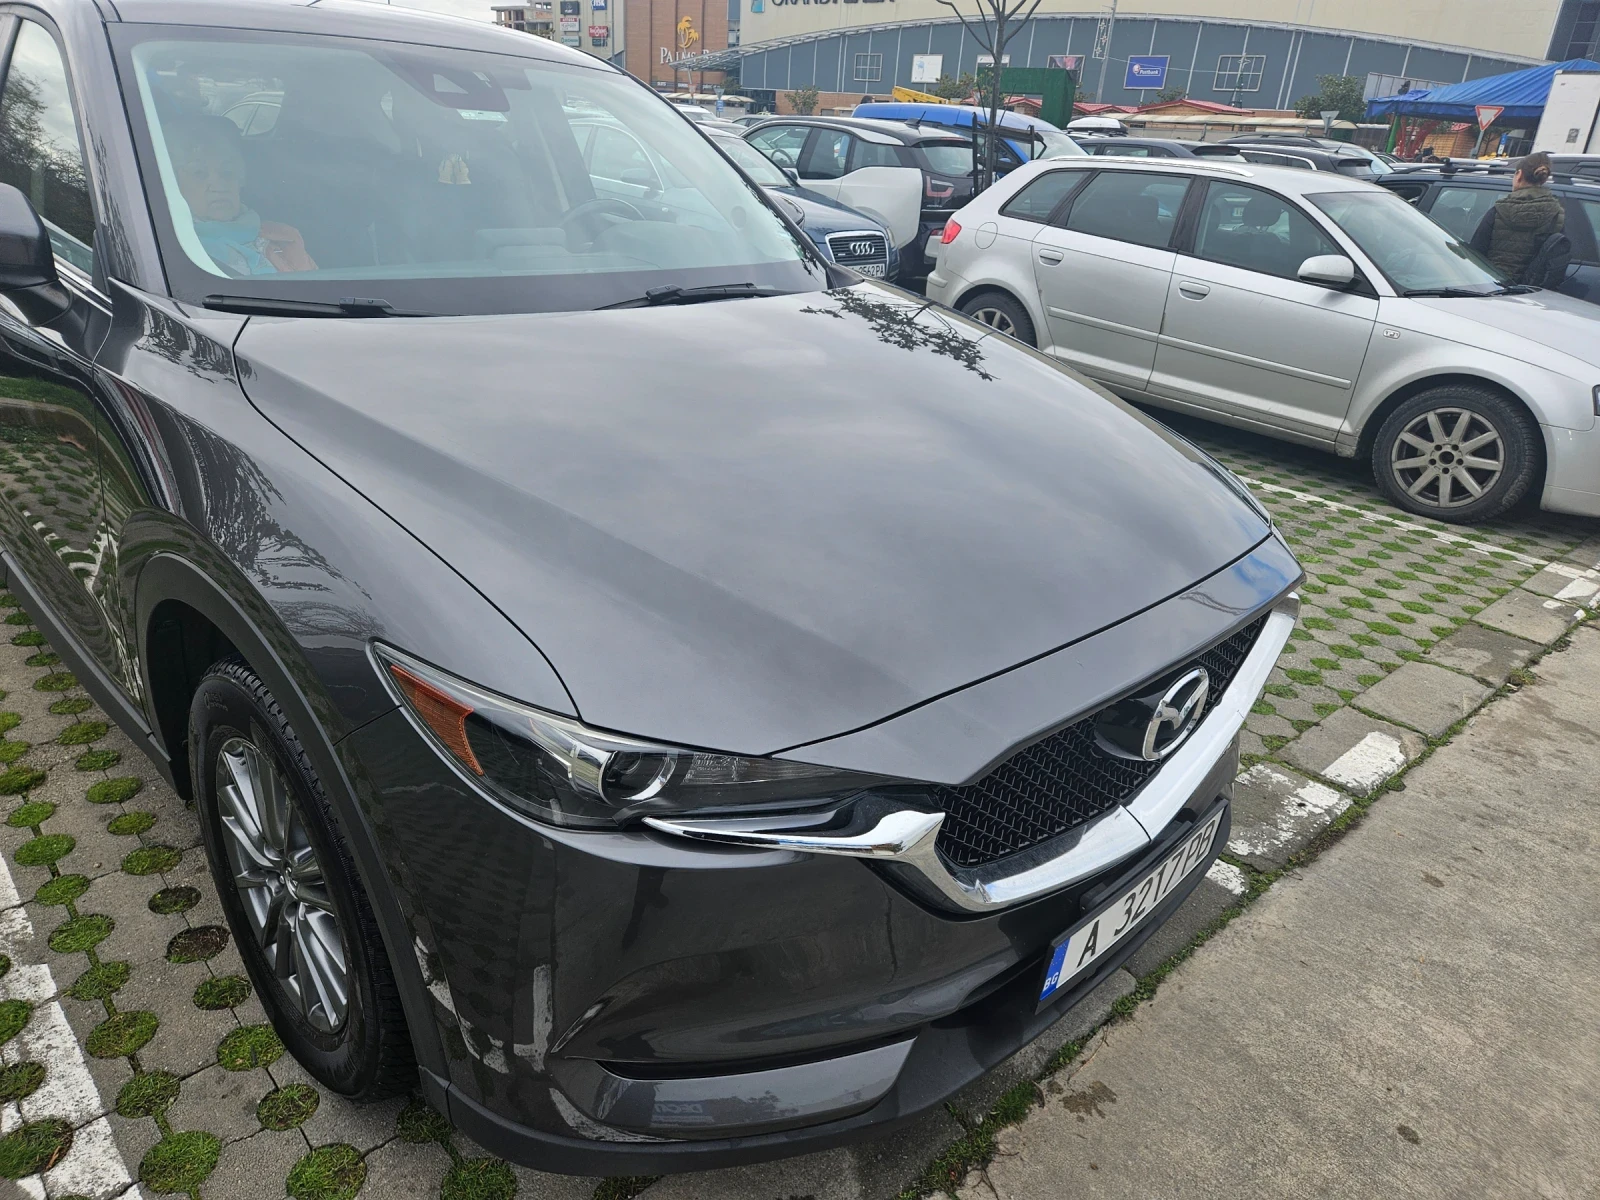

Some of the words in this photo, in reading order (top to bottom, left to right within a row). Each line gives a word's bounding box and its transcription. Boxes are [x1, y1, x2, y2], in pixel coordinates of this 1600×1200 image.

[1077, 919, 1100, 968] A
[1113, 819, 1216, 937] 3217PB
[1042, 971, 1060, 992] BG
